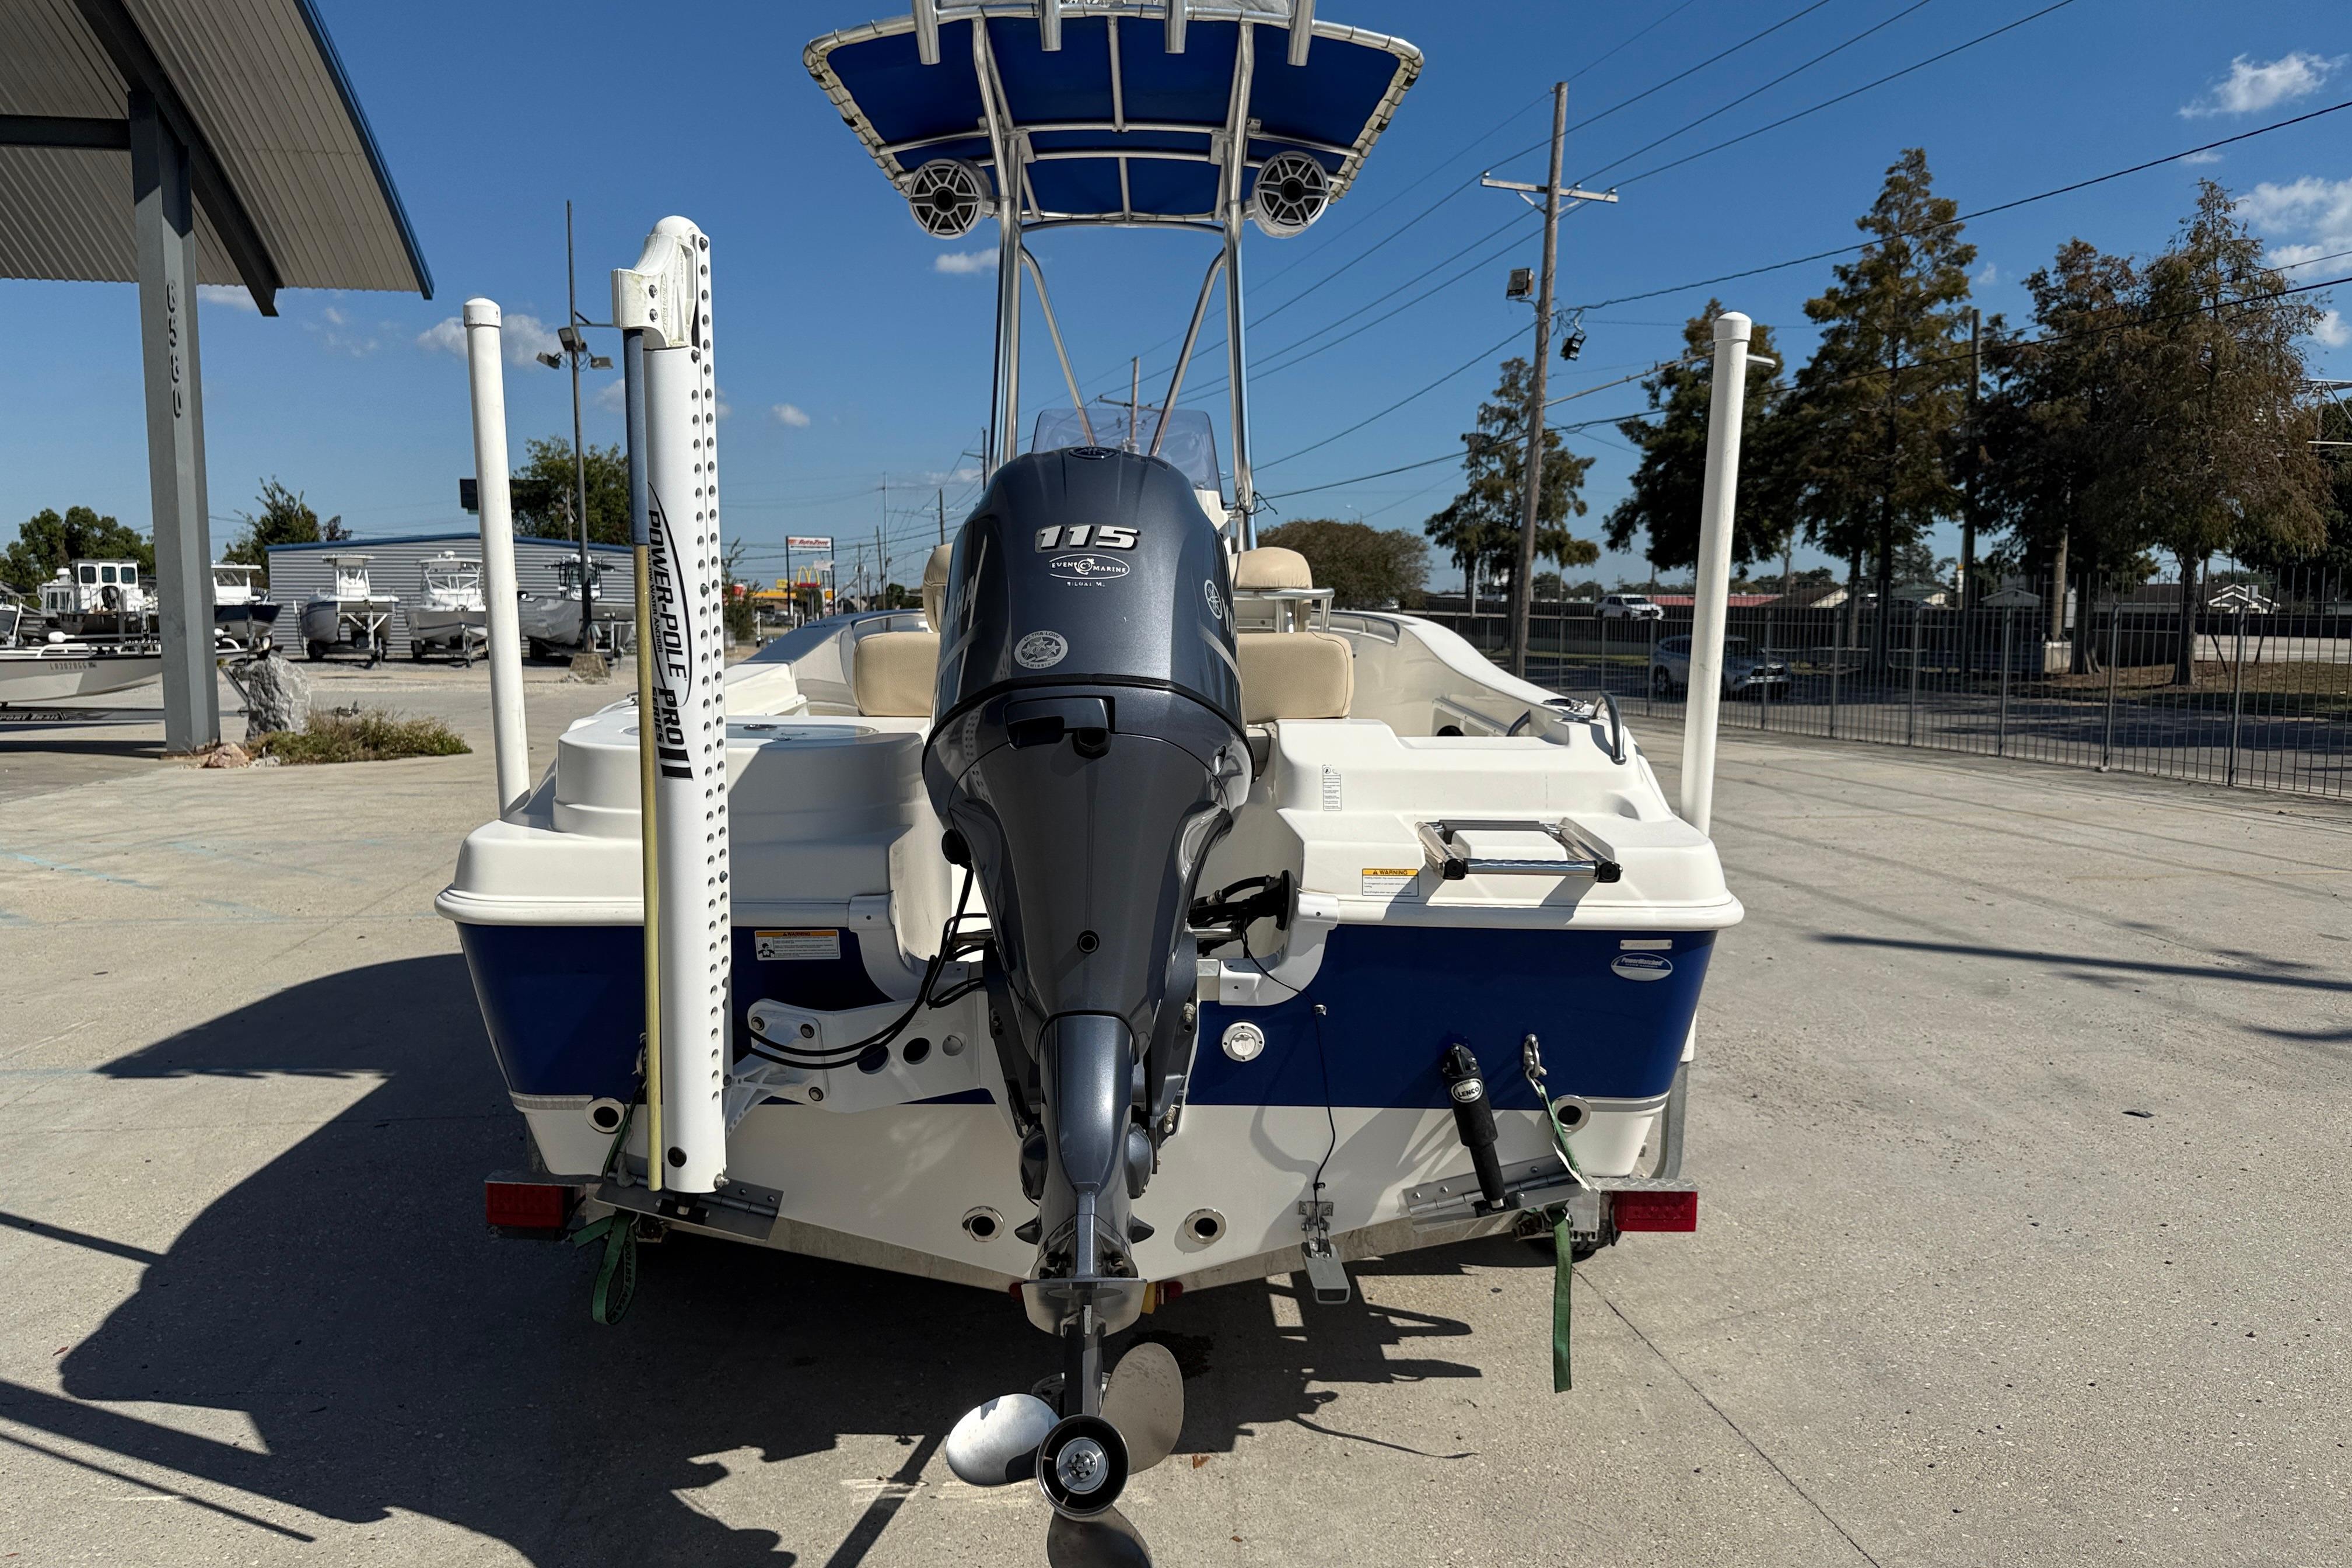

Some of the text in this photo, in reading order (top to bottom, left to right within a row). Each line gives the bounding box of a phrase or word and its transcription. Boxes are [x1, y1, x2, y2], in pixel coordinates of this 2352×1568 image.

[1040, 525, 1142, 551] 115
[1093, 565, 1127, 573] MARINE
[648, 509, 687, 679] POWER-POLE
[653, 617, 663, 653] ANCHOR
[652, 687, 664, 744] SERIES
[657, 688, 685, 746] PRO
[1457, 1086, 1479, 1097] LENCO
